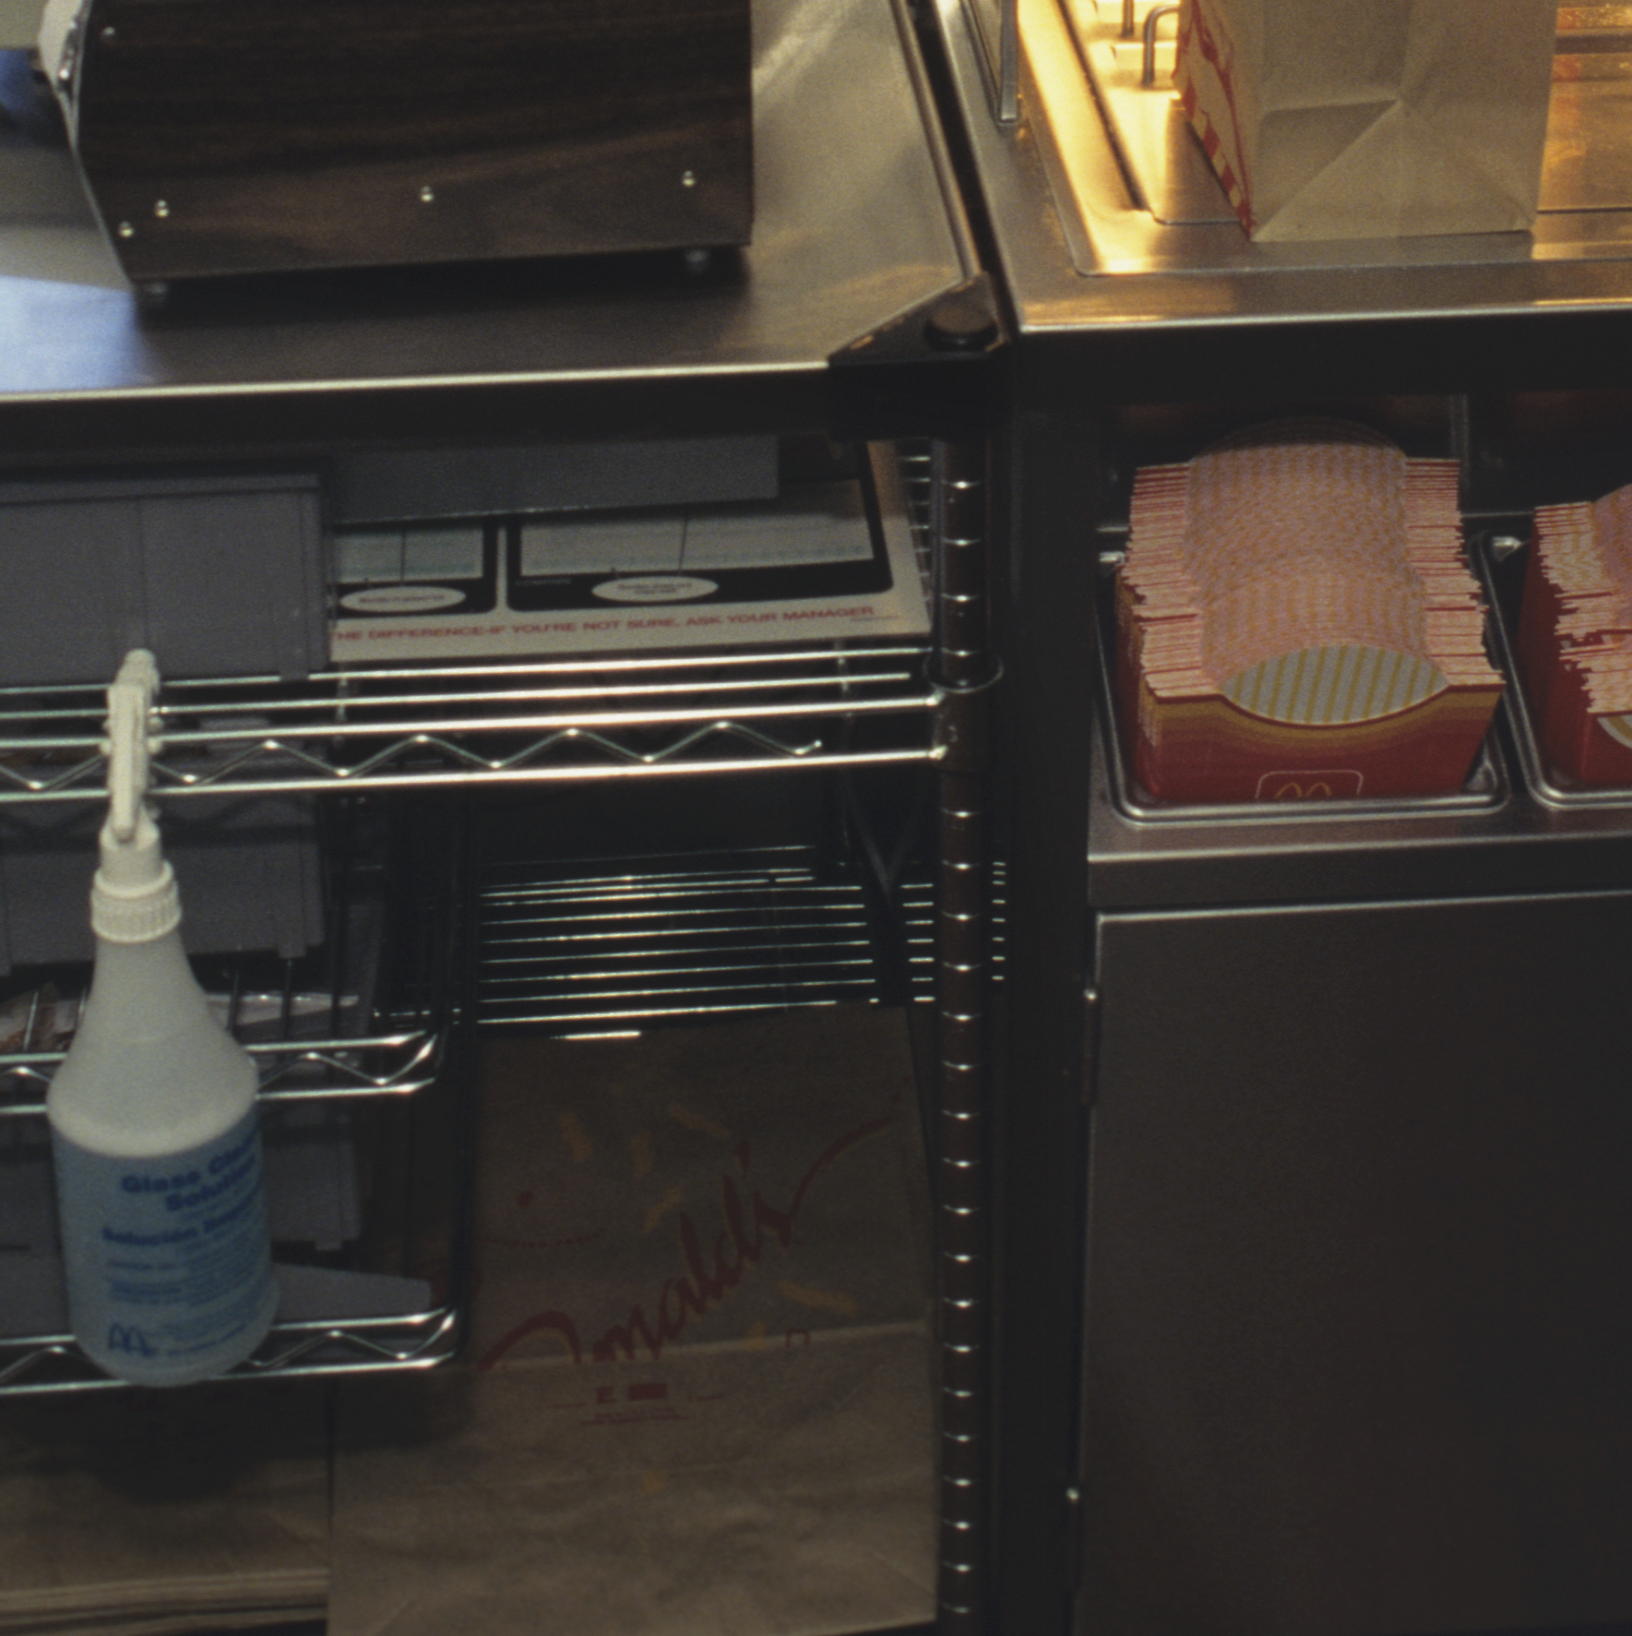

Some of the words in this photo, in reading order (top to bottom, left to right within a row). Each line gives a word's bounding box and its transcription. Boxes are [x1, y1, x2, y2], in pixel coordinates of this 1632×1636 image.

[582, 620, 620, 631] NOT
[686, 616, 722, 627] ASK
[727, 612, 778, 624] YOUR
[782, 605, 875, 621] MANAGER
